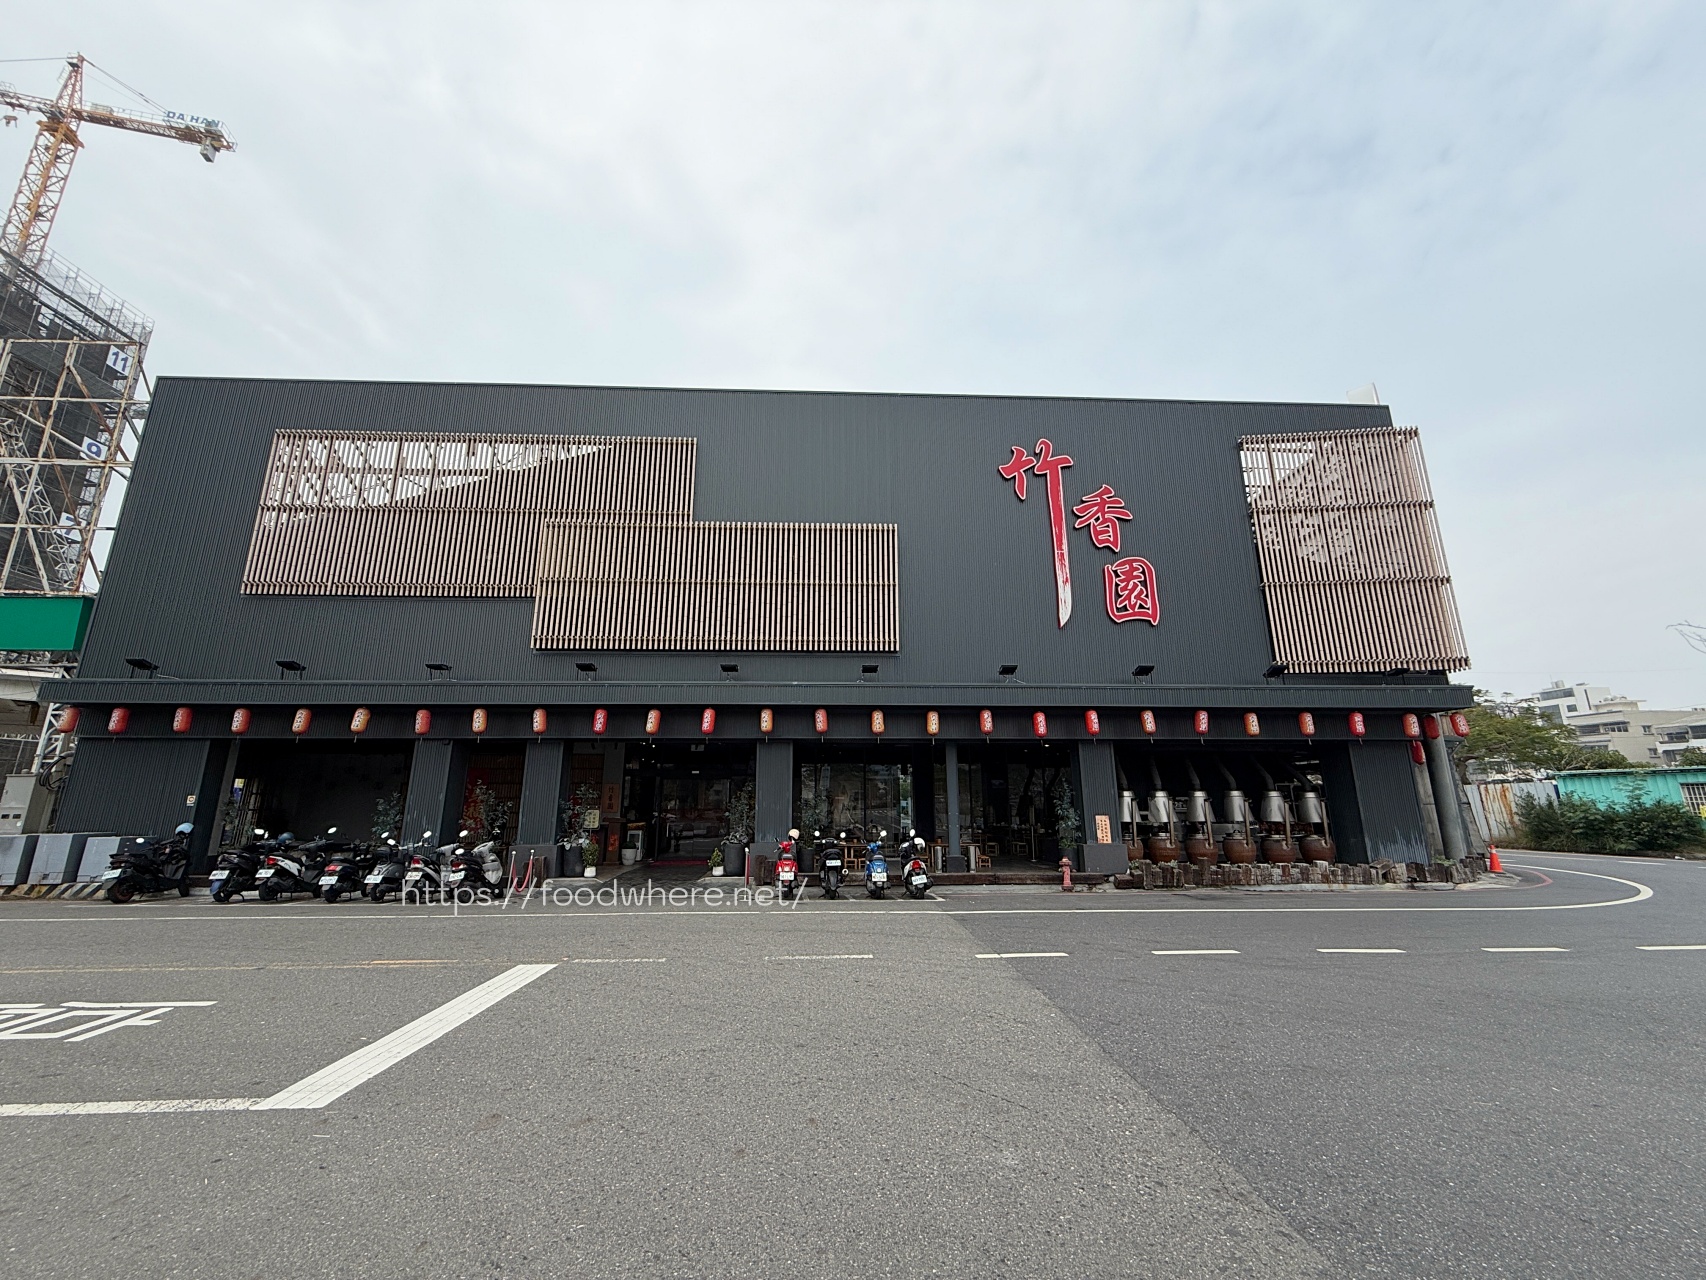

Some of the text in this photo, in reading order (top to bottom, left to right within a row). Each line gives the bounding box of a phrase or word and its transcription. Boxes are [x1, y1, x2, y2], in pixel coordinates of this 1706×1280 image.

[166, 110, 185, 121] DA
[111, 351, 129, 373] 11
[86, 442, 102, 459] 9
[64, 515, 82, 536] 7
[998, 438, 1160, 629] 竹香園
